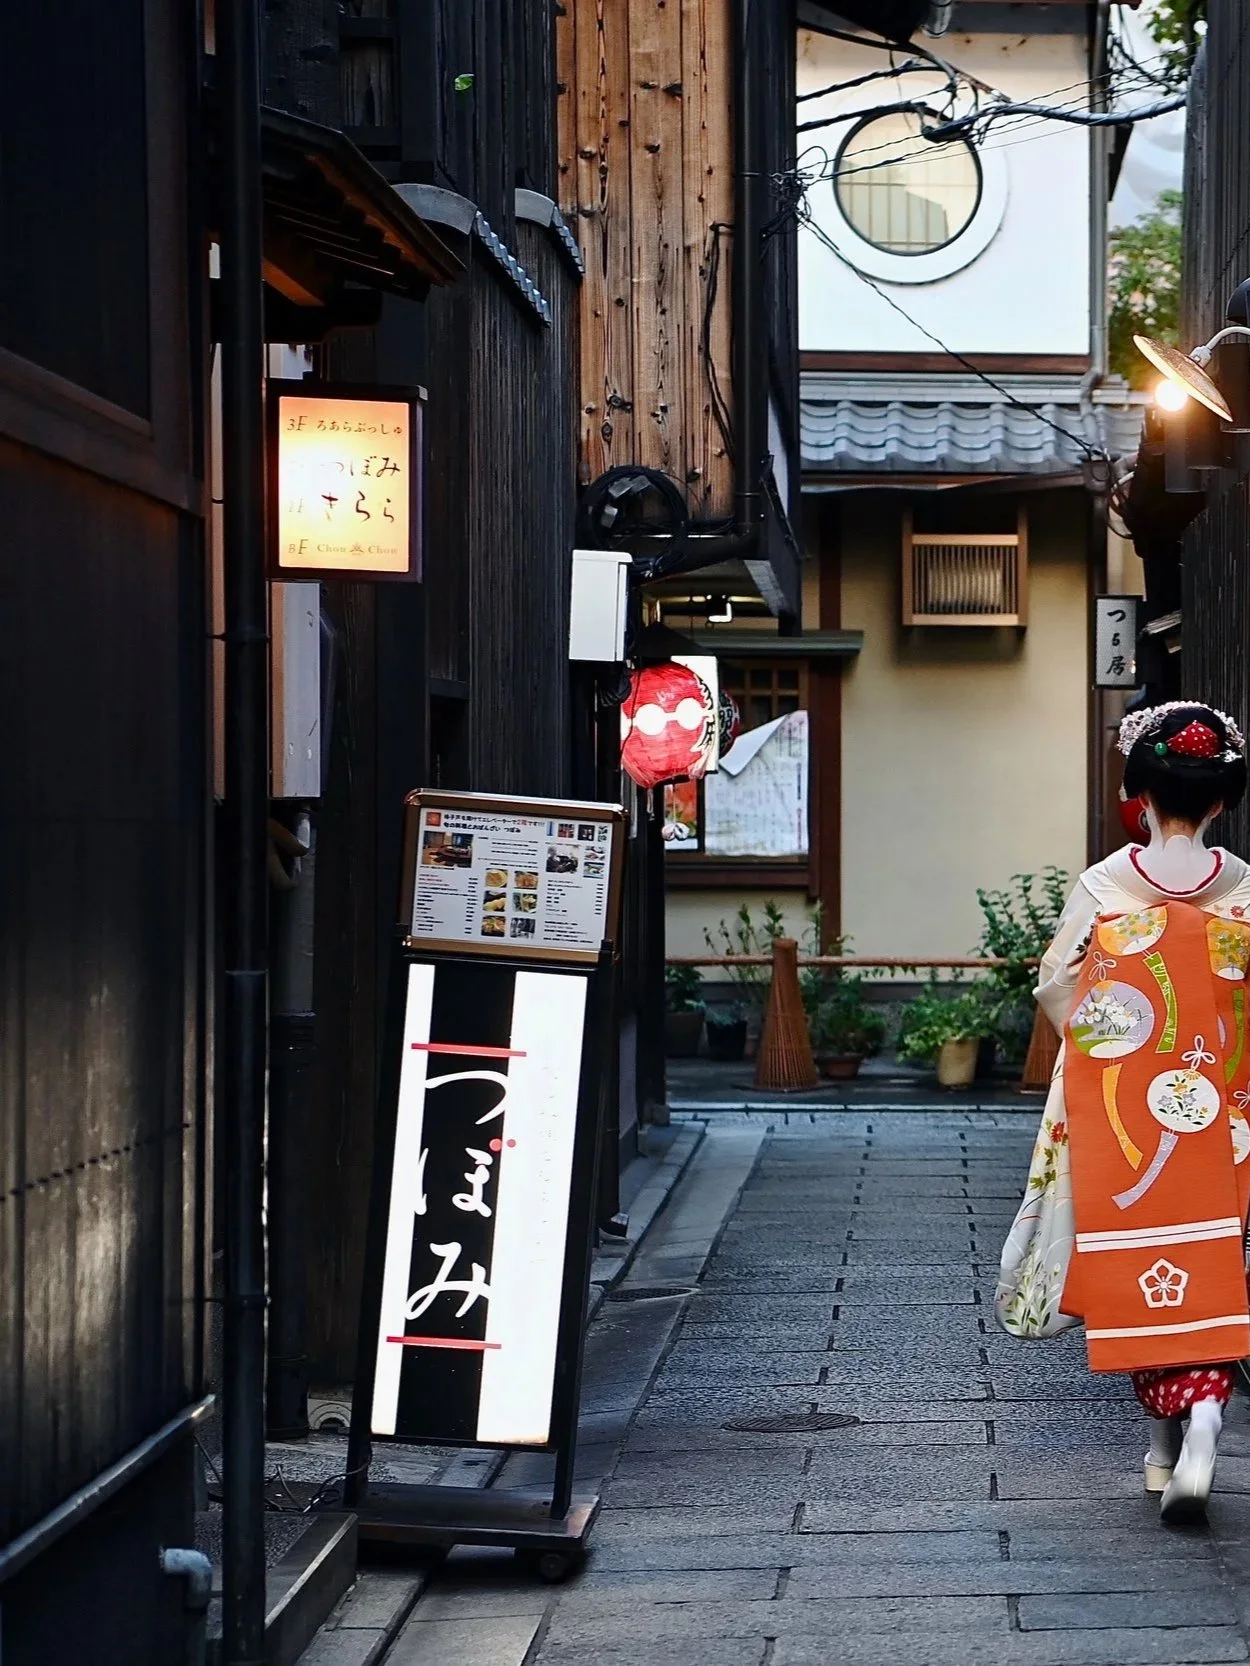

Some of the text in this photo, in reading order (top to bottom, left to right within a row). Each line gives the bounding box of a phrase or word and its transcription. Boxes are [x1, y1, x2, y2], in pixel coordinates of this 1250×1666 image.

[286, 415, 308, 431] 3F
[319, 456, 400, 478] つぼみ
[321, 490, 395, 523] さらら
[402, 1069, 517, 1321] つぼみ
